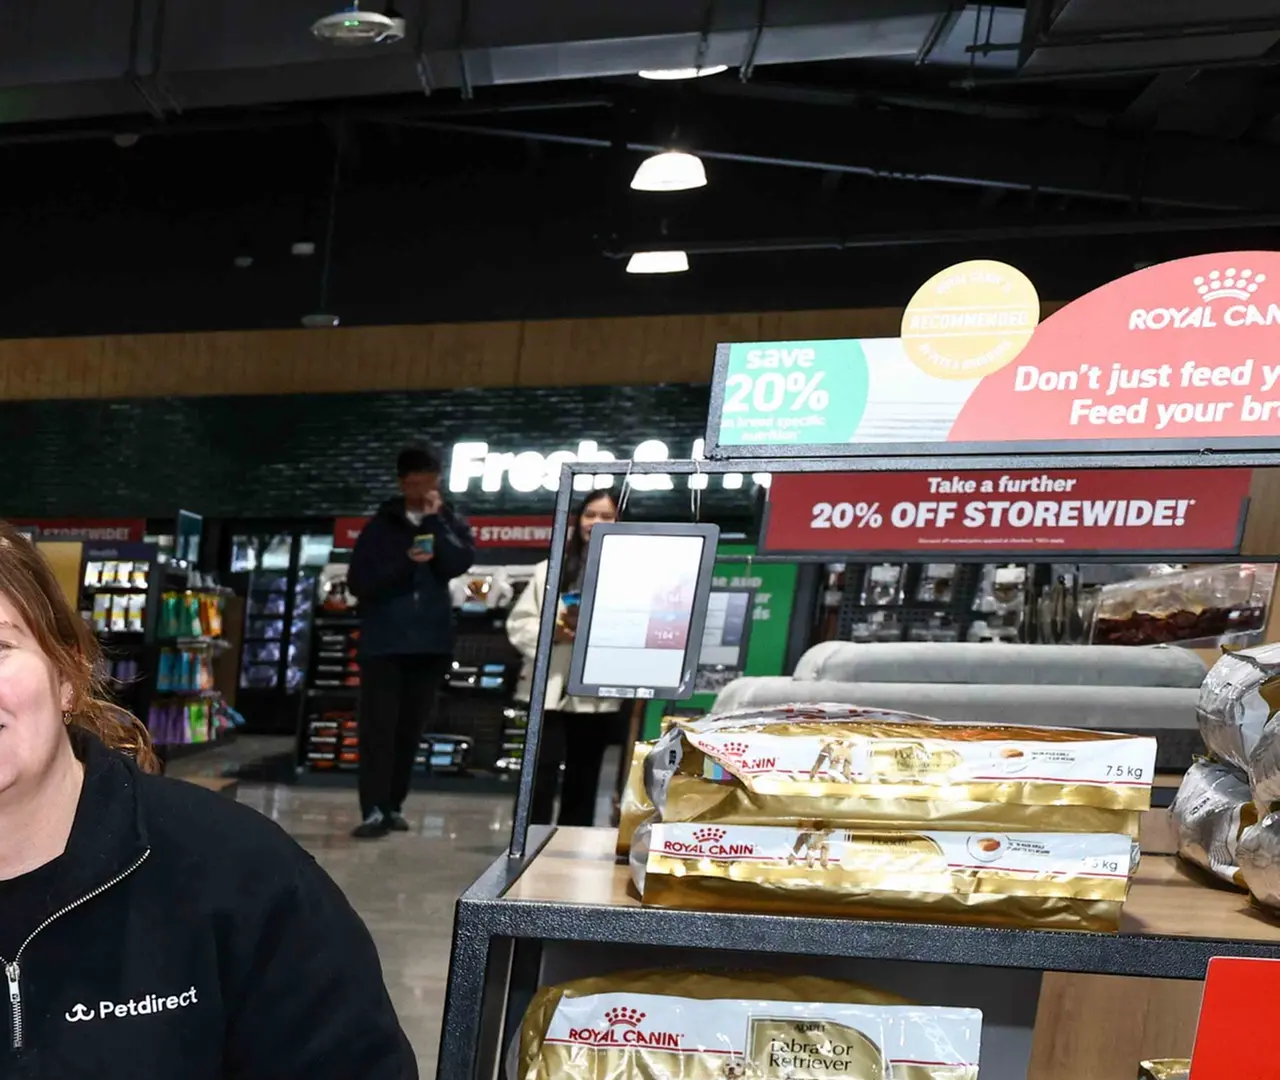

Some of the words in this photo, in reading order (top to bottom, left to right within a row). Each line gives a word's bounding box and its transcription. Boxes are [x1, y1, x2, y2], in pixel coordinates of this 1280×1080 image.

[1129, 305, 1217, 331] ROYAL
[1223, 303, 1280, 327] CAN
[746, 346, 815, 371] save
[1014, 364, 1102, 392] Don't
[1106, 363, 1173, 397] just
[1180, 360, 1254, 388] feed
[724, 371, 829, 413] 20%
[1069, 397, 1149, 426] Feed
[1155, 402, 1234, 430] your
[927, 476, 976, 494] Take
[980, 479, 994, 493] a
[998, 475, 1077, 493] further
[810, 502, 883, 529] 20%
[891, 501, 958, 528] OFF
[1127, 764, 1144, 780] kg
[664, 841, 705, 854] ROYAL
[708, 844, 754, 855] CANIN
[1101, 859, 1119, 872] kg
[99, 986, 199, 1019] Petdirect
[569, 1028, 619, 1043] ROYAL
[623, 1030, 680, 1047] CANIN
[769, 1053, 853, 1072] Retriever
